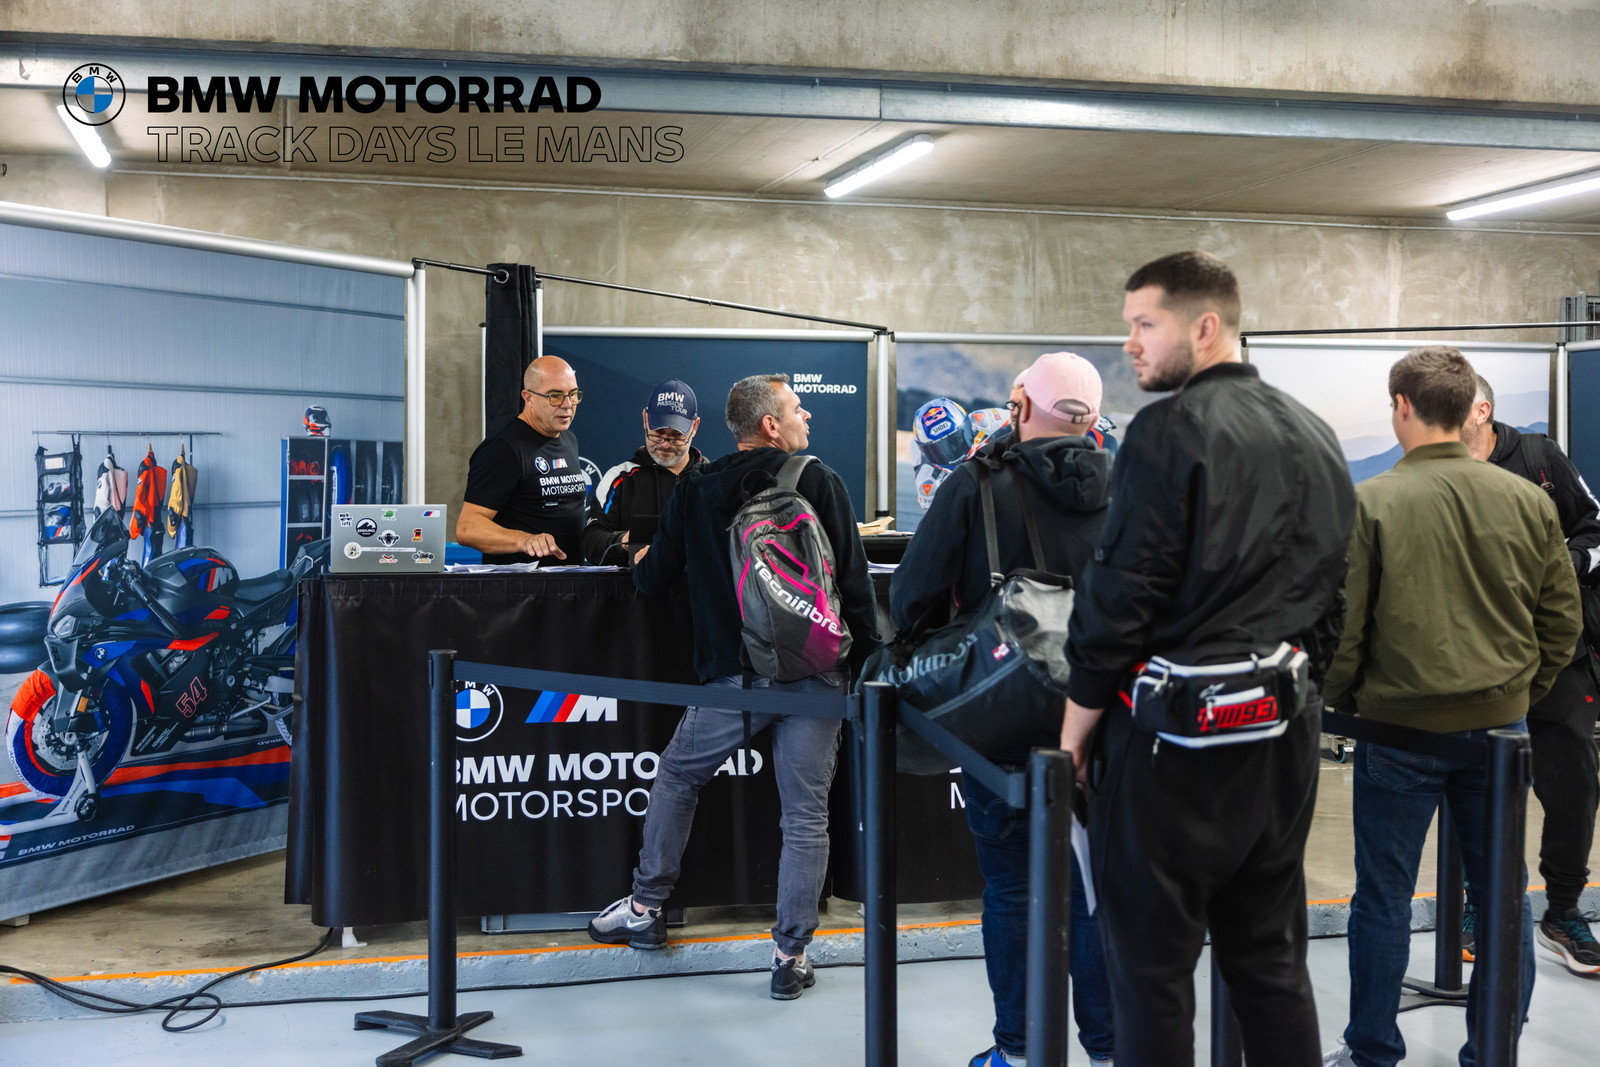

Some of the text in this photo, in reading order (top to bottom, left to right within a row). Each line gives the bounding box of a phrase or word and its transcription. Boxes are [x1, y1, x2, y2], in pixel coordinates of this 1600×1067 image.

[793, 373, 823, 383] BMW
[793, 383, 858, 394] MOTORRAD
[656, 400, 684, 408] PASSION
[657, 392, 685, 403] BMW
[671, 406, 688, 416] TOUR
[539, 475, 560, 486] BMW
[541, 483, 586, 496] MOTORSPORT
[754, 557, 838, 635] Tecnifibre
[456, 680, 496, 697] MW
[175, 676, 208, 718] 54
[456, 748, 764, 785] MW MOTOAD
[456, 787, 651, 822] OTORSPO
[18, 825, 135, 856] BMW MOTORRAD
